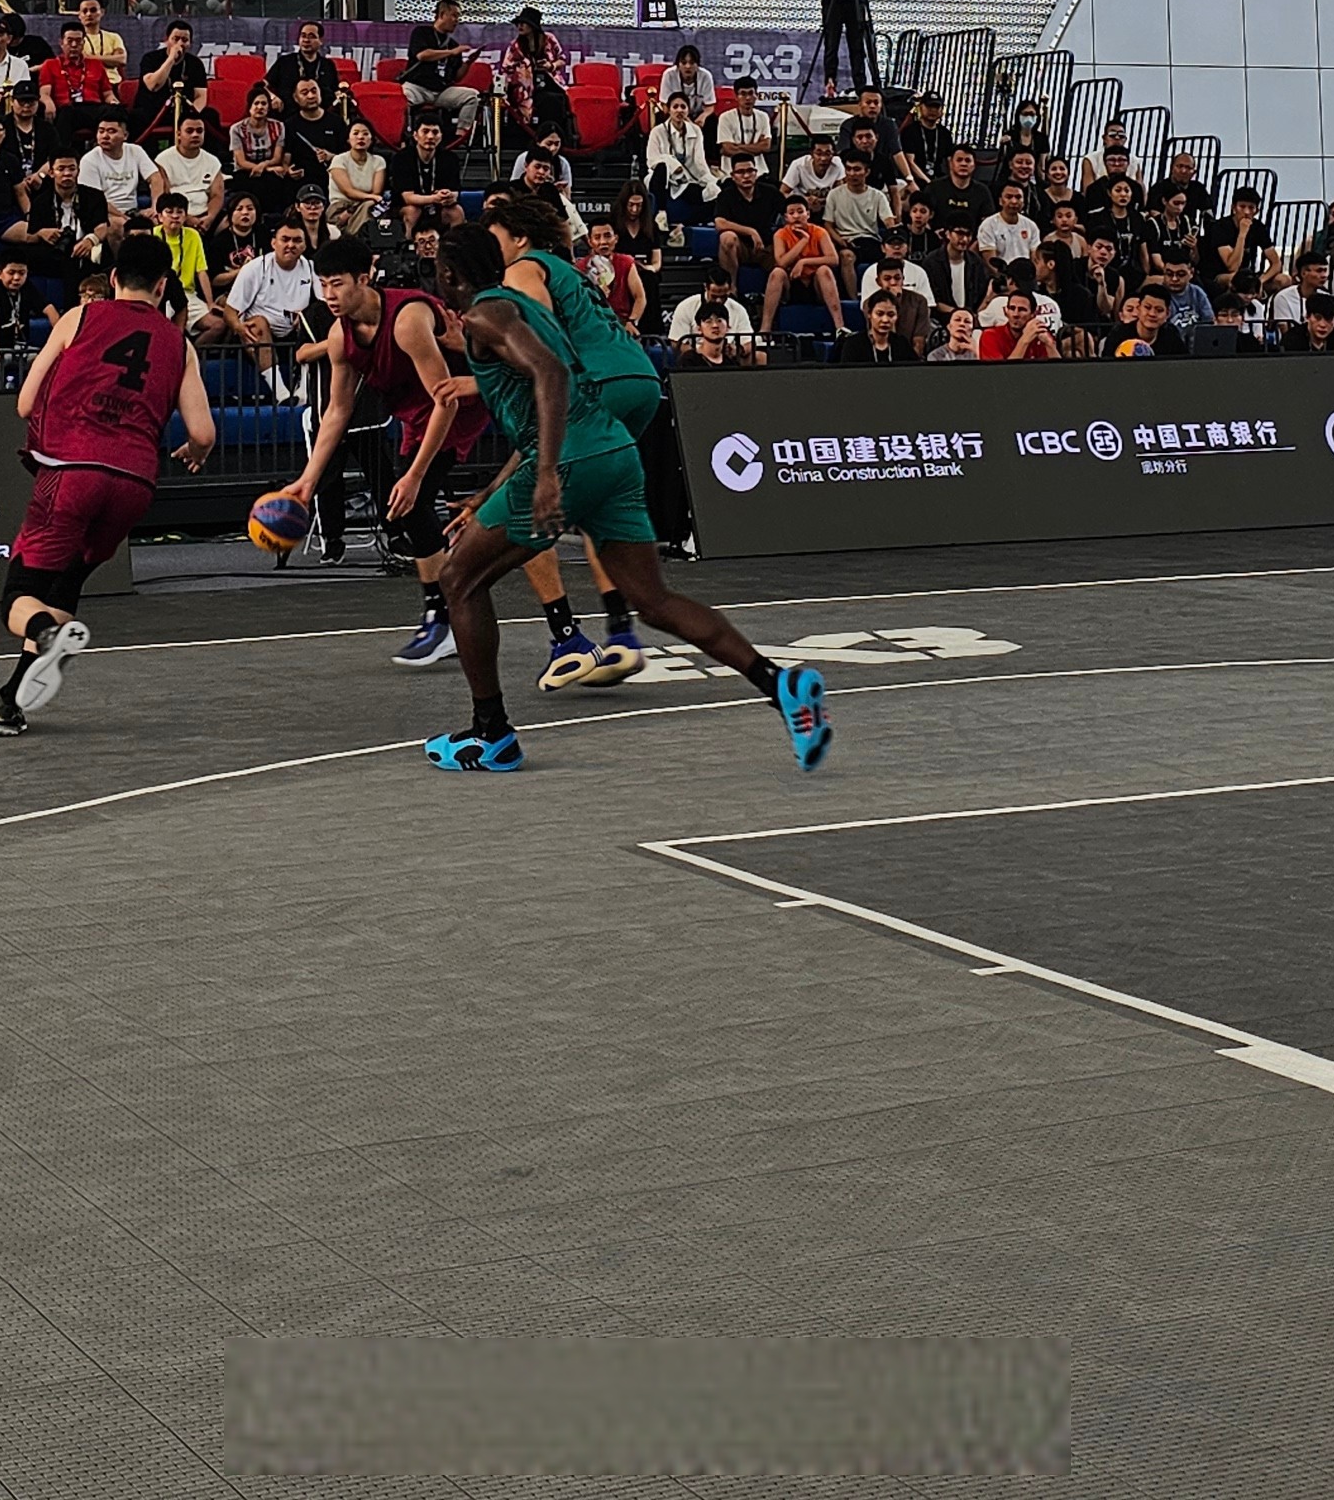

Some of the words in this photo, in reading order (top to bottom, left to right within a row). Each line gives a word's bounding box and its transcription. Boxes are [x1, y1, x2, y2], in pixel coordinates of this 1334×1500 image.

[101, 329, 154, 393] 4
[772, 432, 983, 465] 中国建设银行
[1016, 430, 1081, 455] ICBC
[1132, 420, 1279, 450] 中国工商银行
[778, 467, 824, 484] China
[827, 463, 919, 481] Construction
[925, 461, 965, 477] Bank
